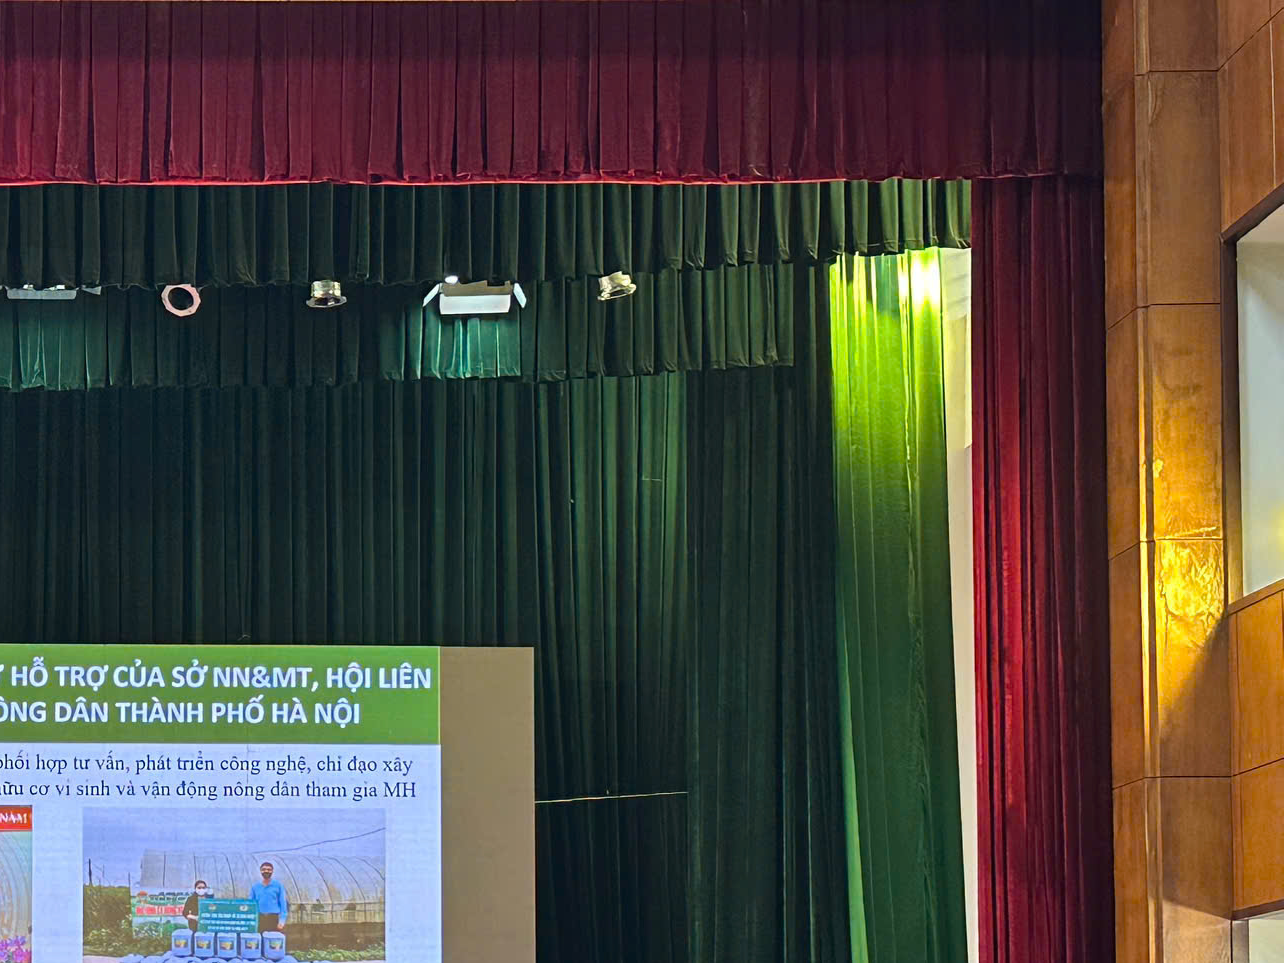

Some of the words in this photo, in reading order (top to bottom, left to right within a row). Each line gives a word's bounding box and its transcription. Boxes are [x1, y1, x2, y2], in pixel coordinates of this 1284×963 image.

[12, 656, 48, 687] HỖ
[54, 664, 108, 692] TRỢ
[113, 659, 165, 688] CỦA
[171, 659, 208, 688] SỞ
[214, 667, 318, 691] NN&MT,
[326, 662, 370, 692] HỘI
[379, 662, 431, 689] LIÊN
[54, 696, 108, 722] DÂN
[116, 697, 203, 723] THÀNH
[212, 695, 264, 723] PHỐ
[272, 697, 307, 723] HÀ
[315, 698, 360, 728] NỘI
[36, 754, 67, 774] hợp
[74, 756, 89, 769] tư
[95, 750, 130, 773] vấn,
[136, 755, 171, 774] phát
[177, 751, 214, 771] triển
[220, 756, 260, 774] công
[266, 756, 311, 774] nghệ,
[348, 756, 377, 774] đạo
[383, 756, 413, 776] xây
[29, 783, 50, 796] cơ
[56, 781, 70, 796] vi
[77, 779, 109, 796] sinh
[116, 780, 135, 796] và
[141, 782, 170, 800] vận
[176, 781, 217, 801] động
[223, 782, 263, 801] nông
[271, 781, 300, 797] dân
[306, 782, 347, 797] tham
[353, 783, 377, 801] gia
[384, 782, 416, 798] MH
